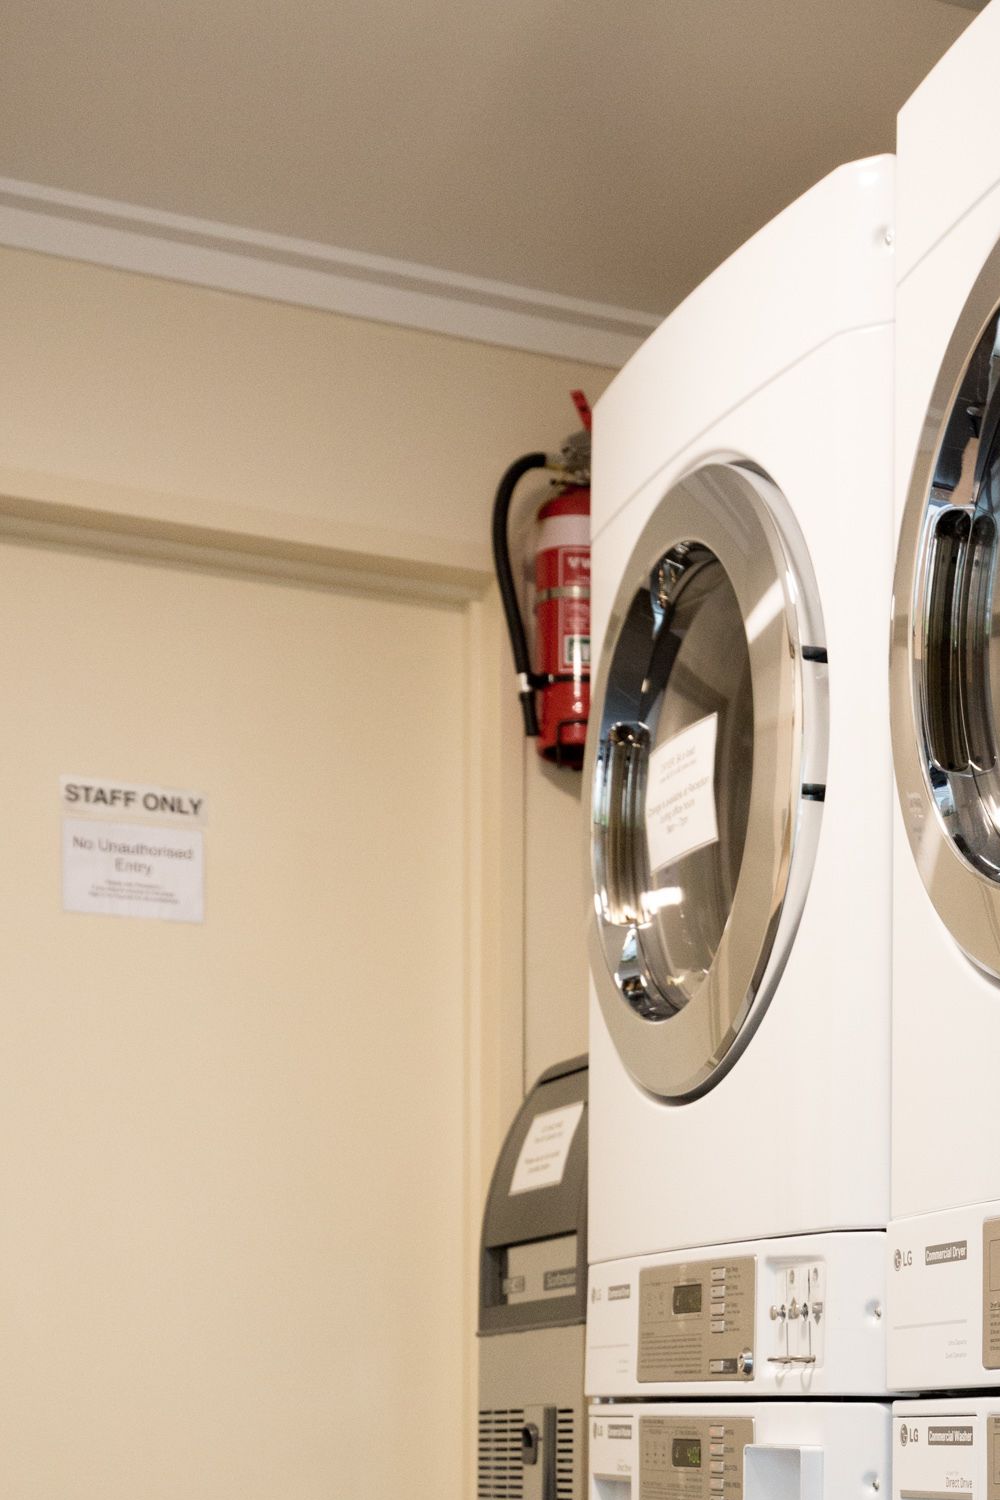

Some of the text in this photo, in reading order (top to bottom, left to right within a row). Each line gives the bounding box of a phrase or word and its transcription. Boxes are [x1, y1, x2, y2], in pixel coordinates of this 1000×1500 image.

[65, 783, 203, 816] STAFF ONLY
[72, 835, 194, 860] No Unauthorised
[114, 857, 152, 876] Entry
